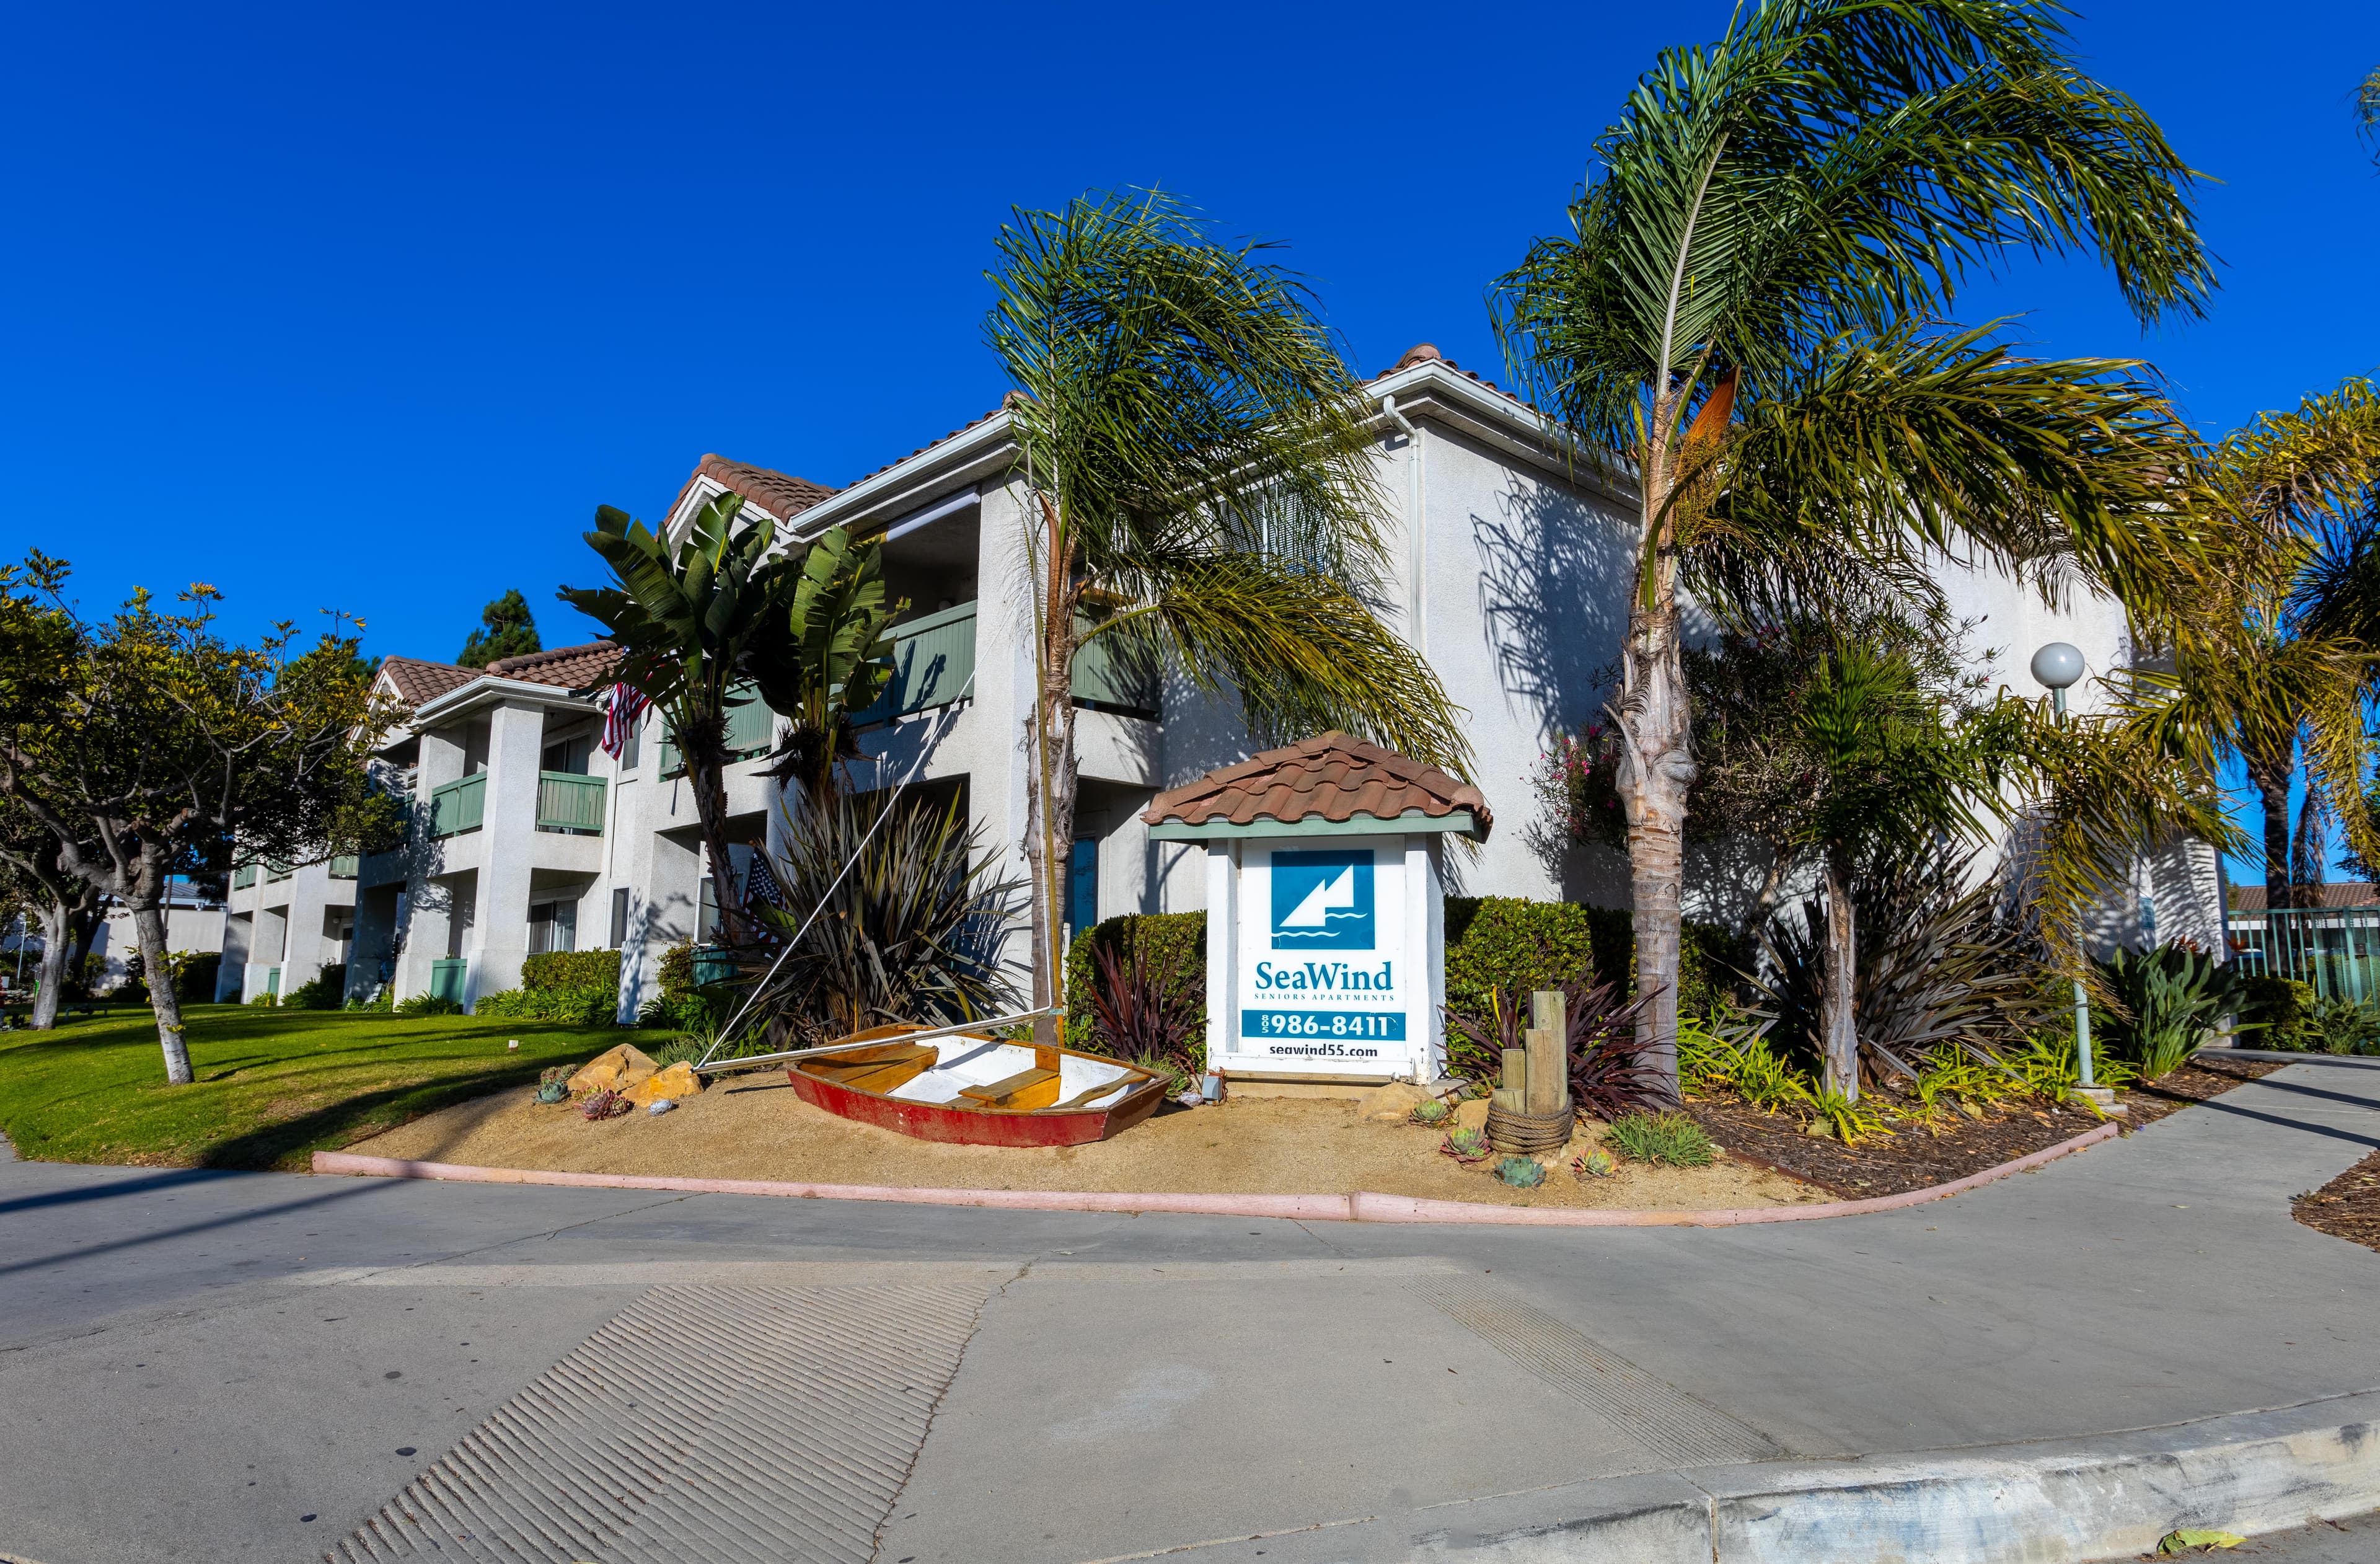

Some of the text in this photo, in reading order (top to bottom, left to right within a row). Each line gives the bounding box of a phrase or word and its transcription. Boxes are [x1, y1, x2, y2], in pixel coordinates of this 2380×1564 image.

[1255, 961, 1394, 991] SeaWind
[1261, 1014, 1388, 1036] 805 986-8411
[1269, 1043, 1378, 1057] seawind55.com
